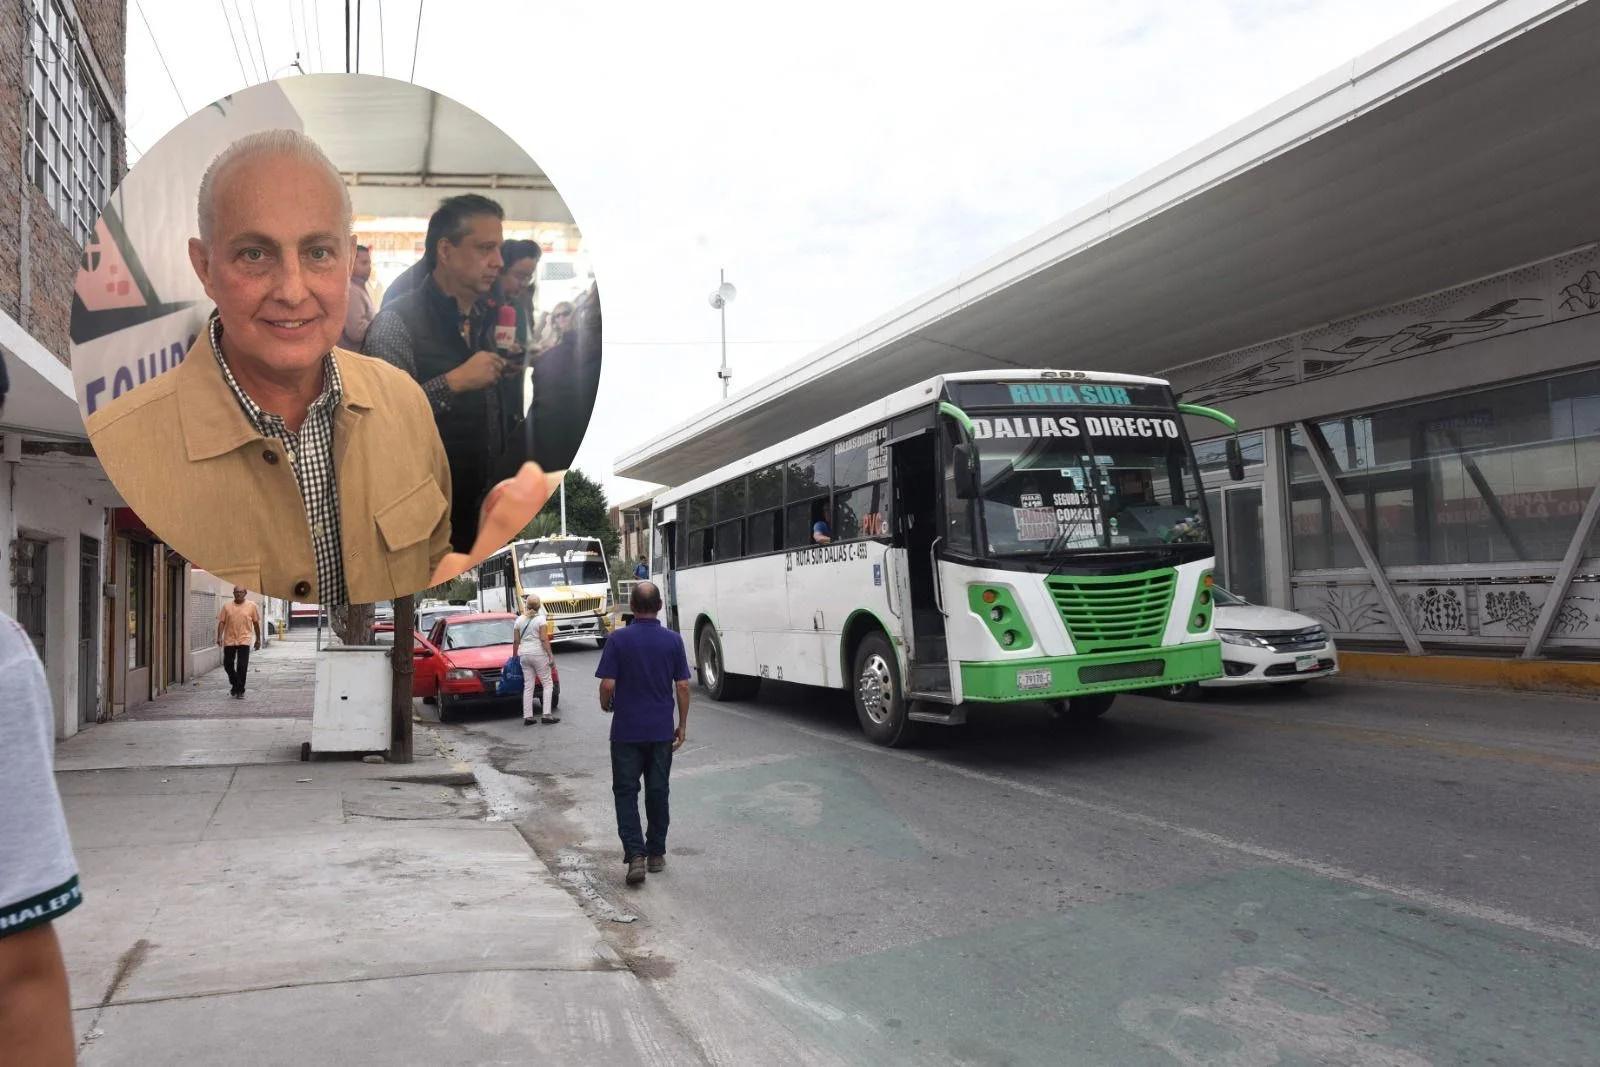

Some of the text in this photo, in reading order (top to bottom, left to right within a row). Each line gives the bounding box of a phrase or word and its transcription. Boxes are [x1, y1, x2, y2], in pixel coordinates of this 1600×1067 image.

[1007, 384, 1131, 405] RUTA SUR
[973, 417, 1179, 439] DALIAS DIRECTO
[1053, 493, 1080, 506] SEGURO
[795, 550, 810, 566] RUTA
[812, 548, 824, 565] SUR
[825, 545, 847, 563] DALIAS
